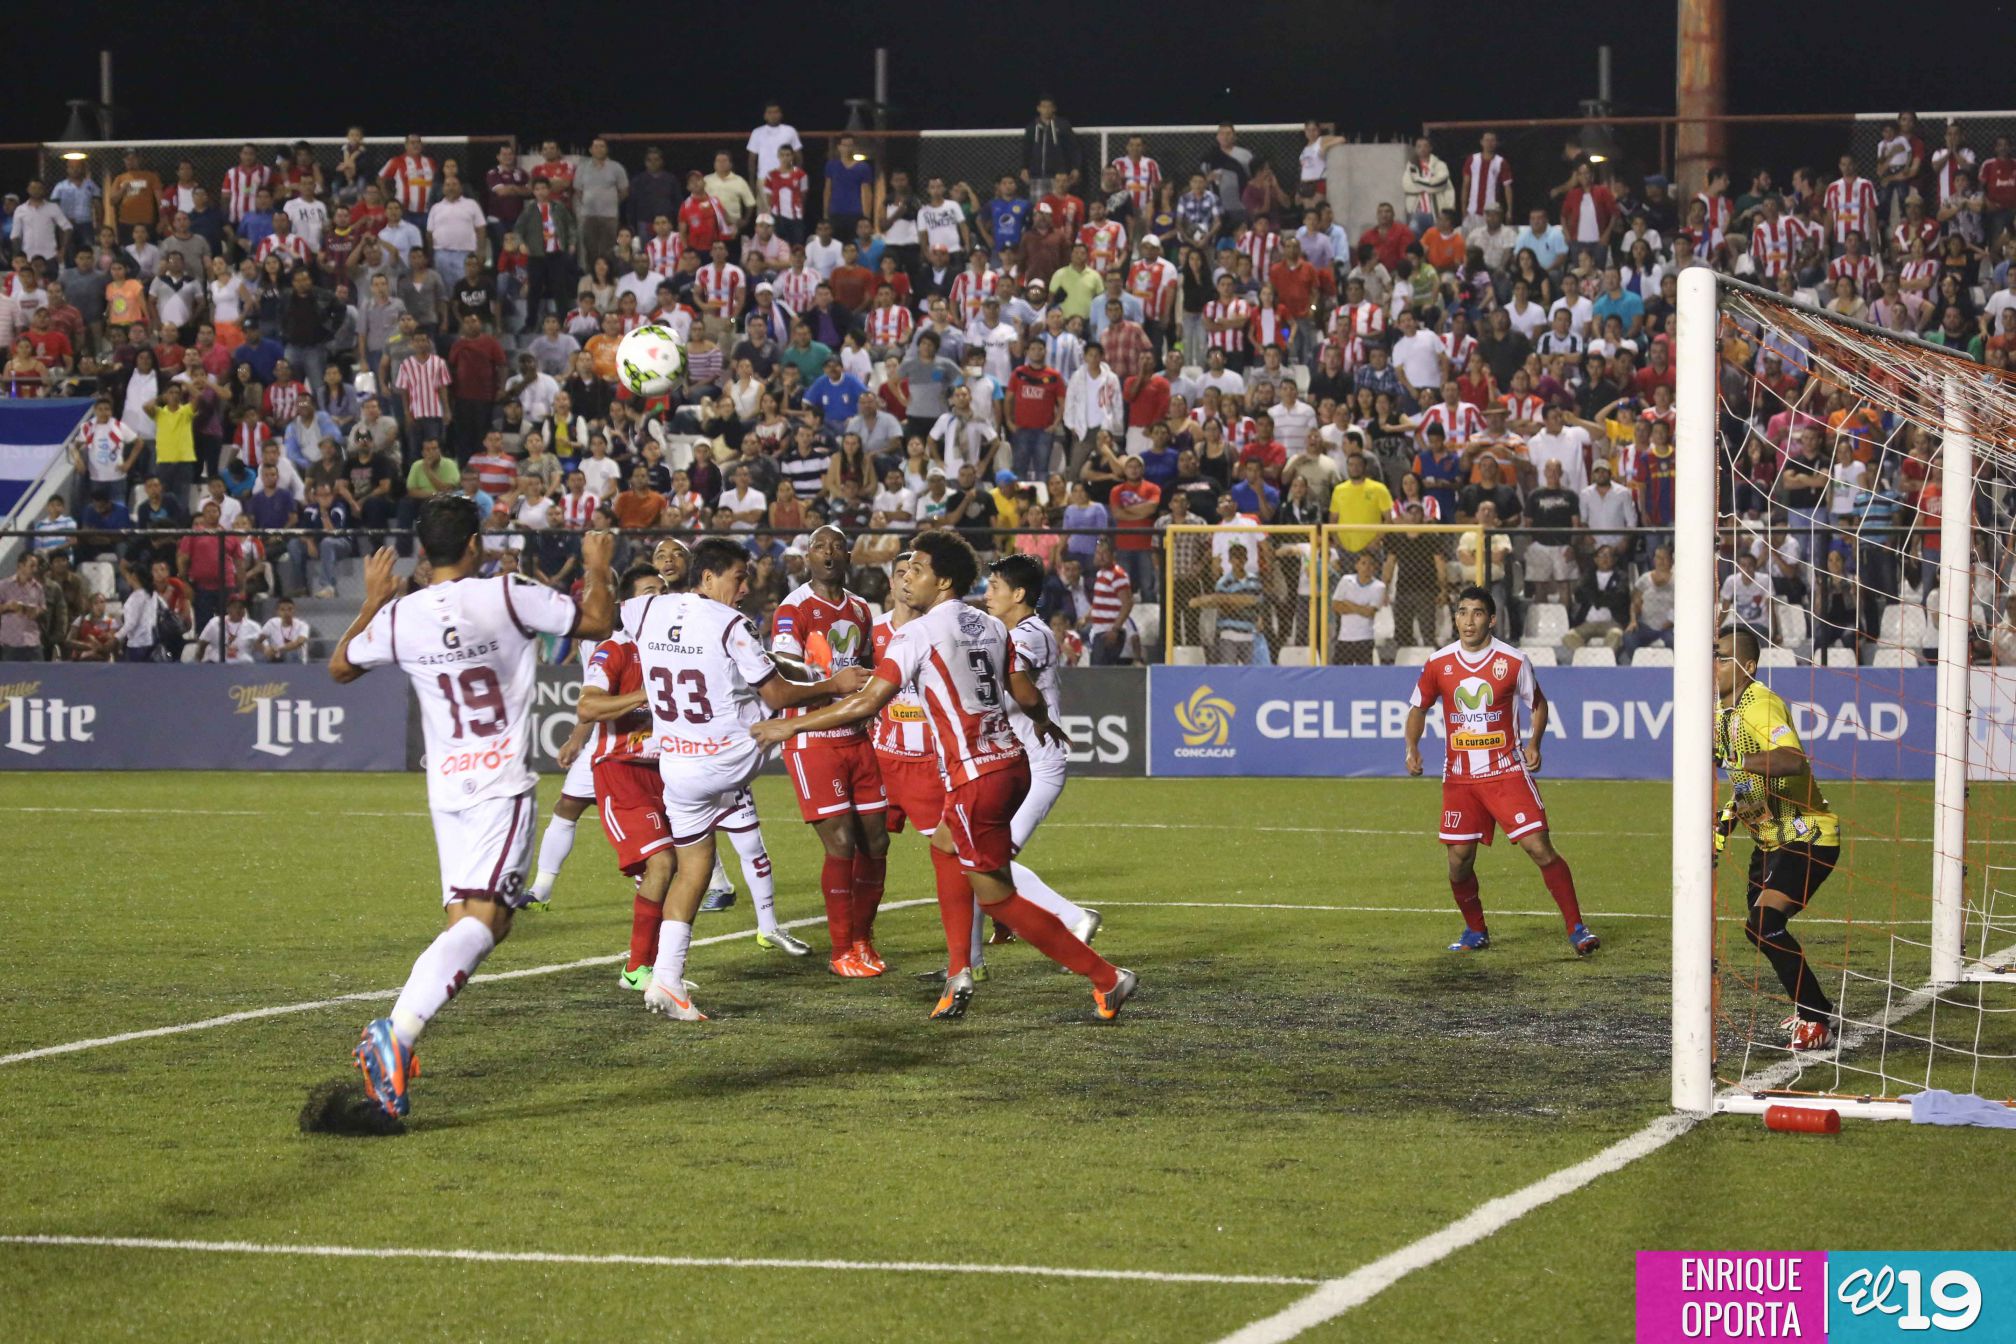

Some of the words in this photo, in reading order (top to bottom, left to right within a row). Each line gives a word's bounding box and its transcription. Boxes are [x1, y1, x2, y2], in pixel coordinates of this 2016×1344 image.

[417, 640, 500, 666] GATORADE
[647, 642, 704, 655] GATORADE
[967, 648, 1001, 708] 3
[228, 681, 290, 714] Miller
[437, 665, 509, 740] 19
[649, 666, 714, 724] 33
[4, 696, 97, 755] Lite
[251, 698, 345, 757] Lite
[1255, 700, 1446, 739] CELEBR
[1173, 747, 1237, 758] CONCACAF
[1455, 735, 1464, 746] la
[1465, 735, 1501, 747] curacao
[832, 778, 845, 797] 2
[646, 811, 661, 830] 7
[1443, 811, 1462, 829] 17
